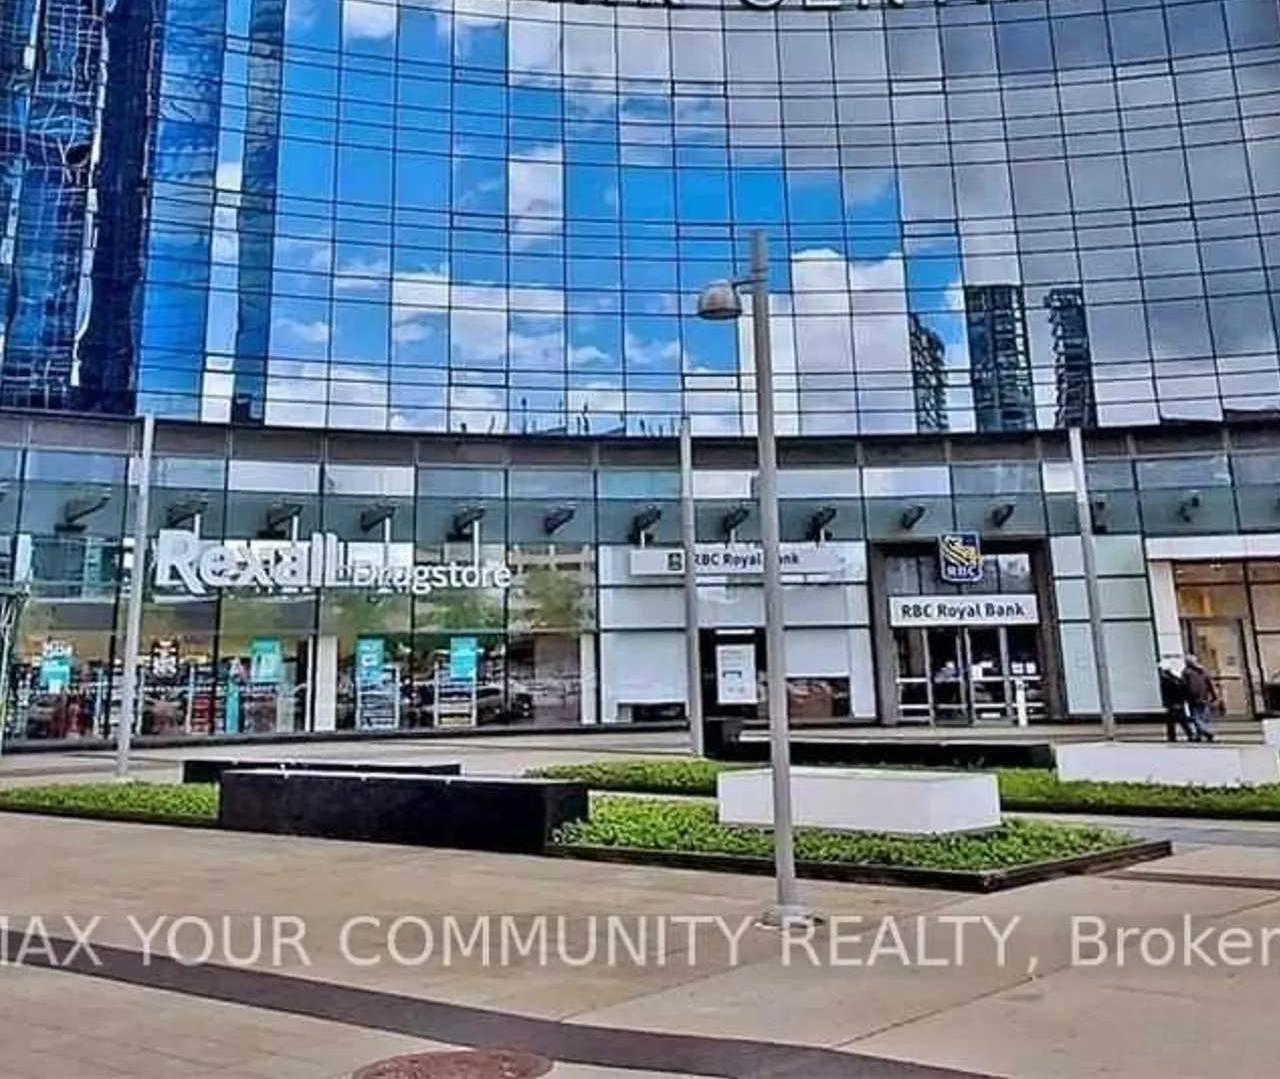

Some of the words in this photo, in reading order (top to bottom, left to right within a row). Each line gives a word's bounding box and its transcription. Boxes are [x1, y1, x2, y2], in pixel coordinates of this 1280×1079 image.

[155, 529, 343, 594] Rexall
[723, 552, 761, 569] Royal
[901, 604, 933, 618] RBC
[937, 603, 982, 619] Royal
[985, 602, 1025, 616] Bank
